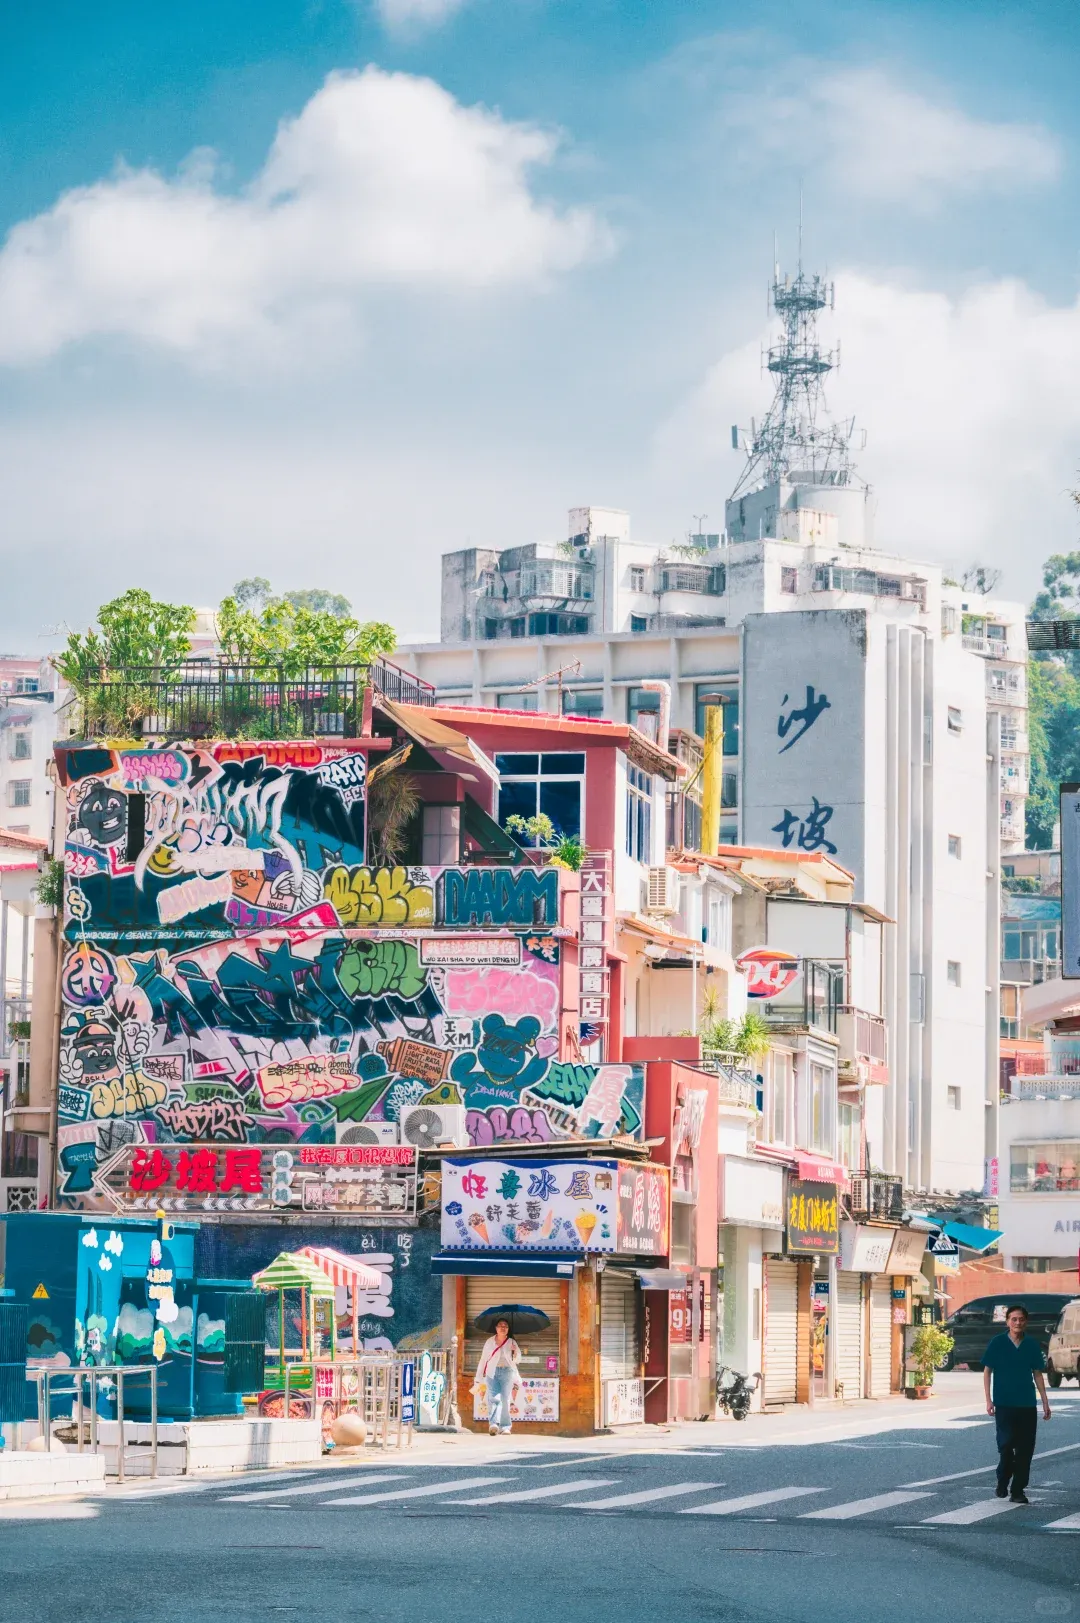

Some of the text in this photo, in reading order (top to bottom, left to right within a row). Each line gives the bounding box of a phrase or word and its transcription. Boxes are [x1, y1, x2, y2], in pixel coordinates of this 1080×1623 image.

[771, 685, 838, 855] 沙坡
[740, 961, 789, 989] DQ
[130, 1147, 263, 1193] 沙坡尾
[300, 1147, 413, 1165] 我在厦门很想你
[462, 1169, 593, 1201] 怪兽冰屋
[485, 1201, 542, 1223] 舒芙蕾
